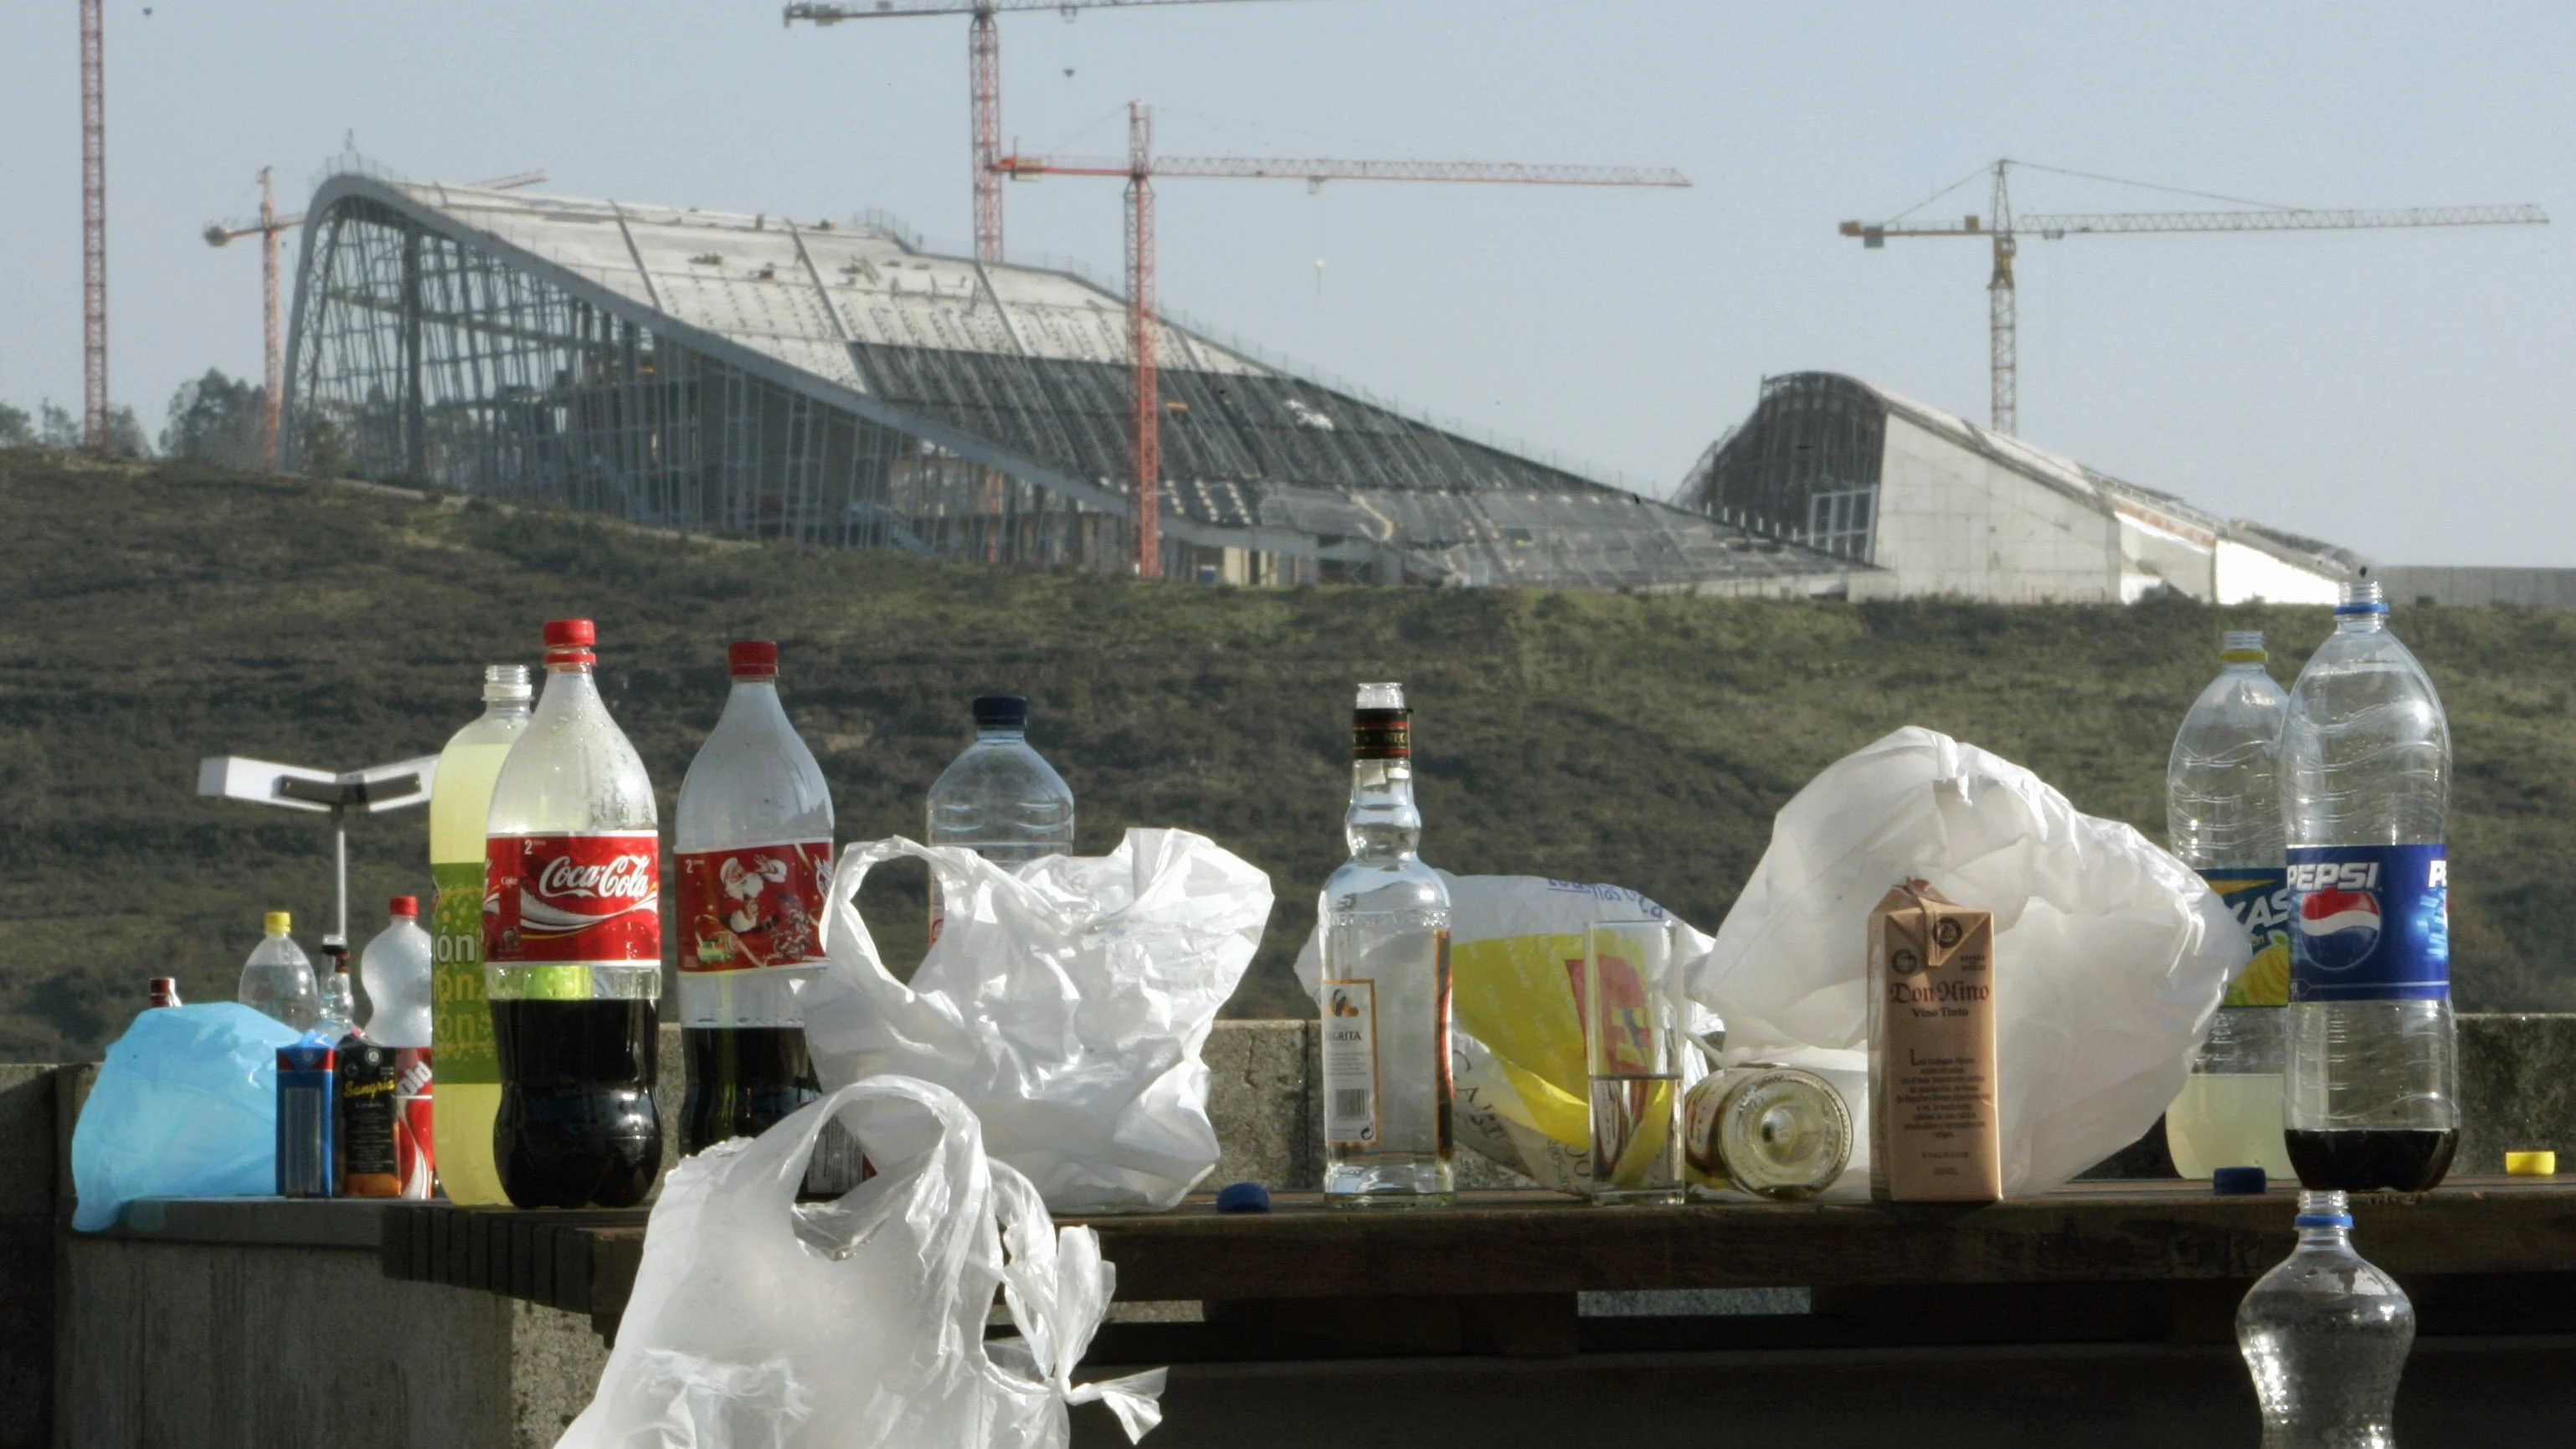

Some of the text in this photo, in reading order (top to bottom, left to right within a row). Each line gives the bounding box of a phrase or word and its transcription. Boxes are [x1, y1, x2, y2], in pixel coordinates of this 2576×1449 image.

[524, 840, 533, 855] 2
[538, 855, 650, 899] Coca-Cola
[685, 859, 694, 874] 2
[2287, 861, 2380, 891] PEPSI
[432, 926, 476, 962] ón
[434, 966, 476, 1001] ón
[1890, 982, 1934, 1004] Don
[1912, 1007, 1969, 1018] Vino Tinto
[396, 1060, 433, 1097] ola
